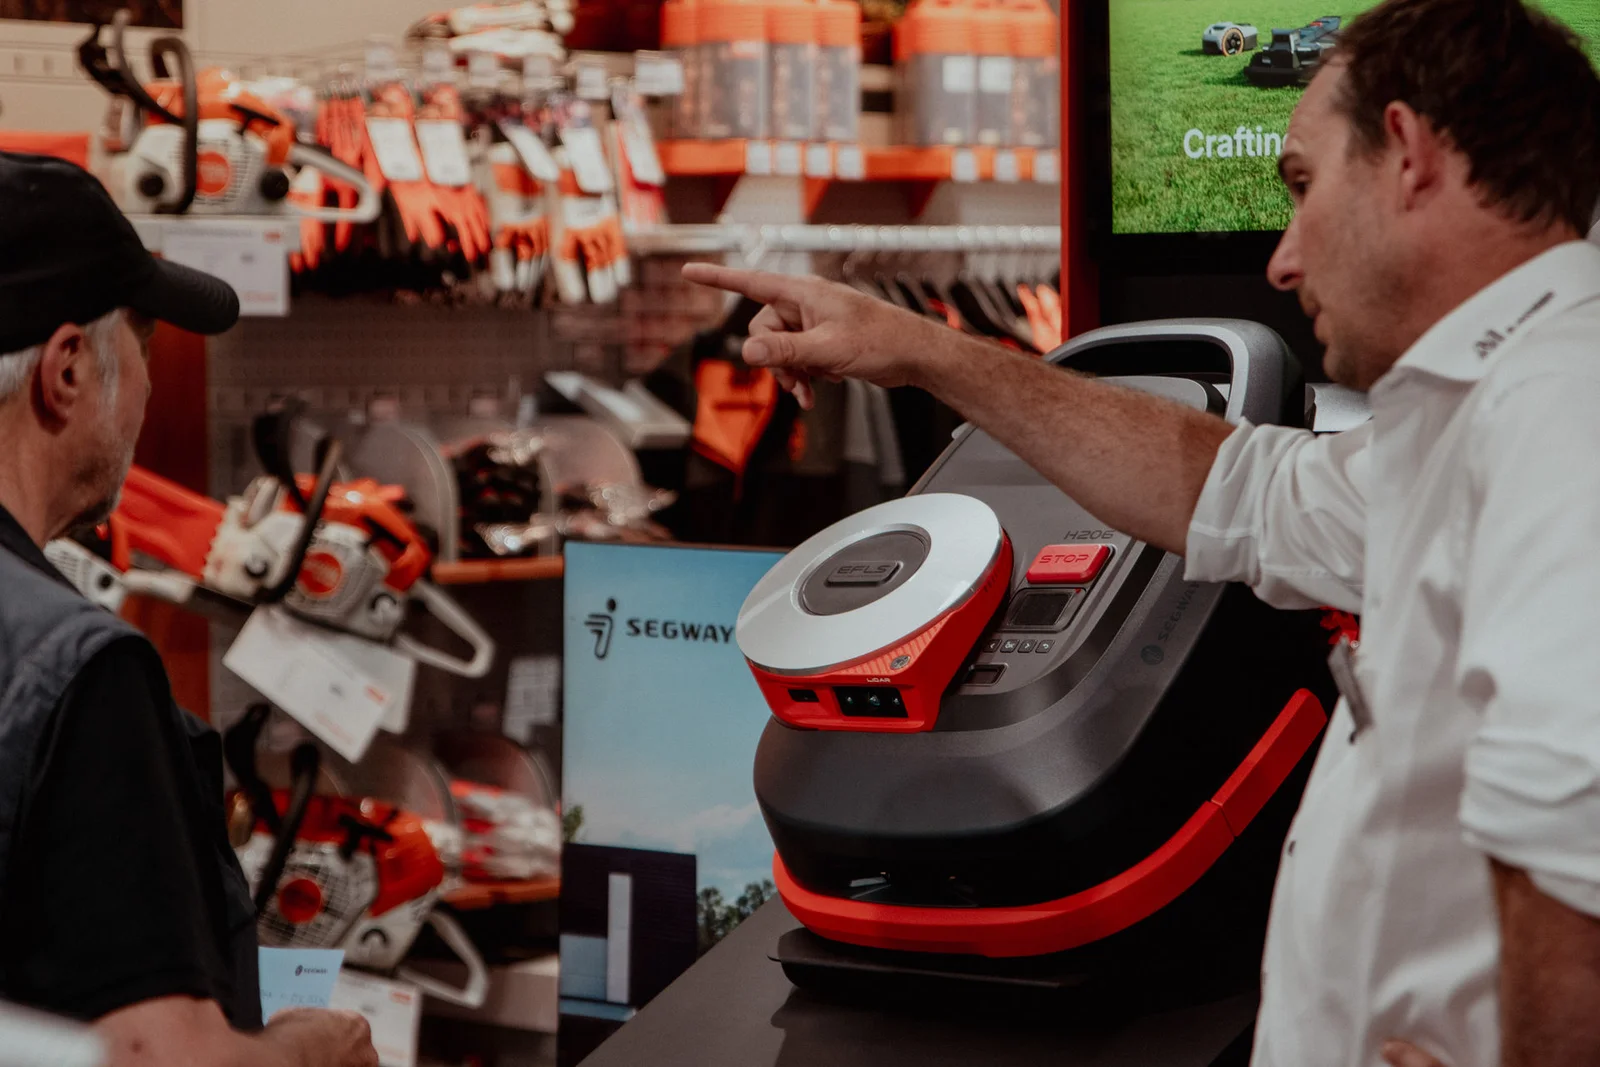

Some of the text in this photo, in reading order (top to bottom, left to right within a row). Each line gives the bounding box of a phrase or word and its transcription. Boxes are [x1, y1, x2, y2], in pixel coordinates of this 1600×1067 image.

[1183, 125, 1289, 159] Craftin
[1063, 529, 1116, 540] H206
[1039, 554, 1089, 564] STOP
[837, 565, 892, 575] EFLS
[626, 618, 734, 643] SEGWAY
